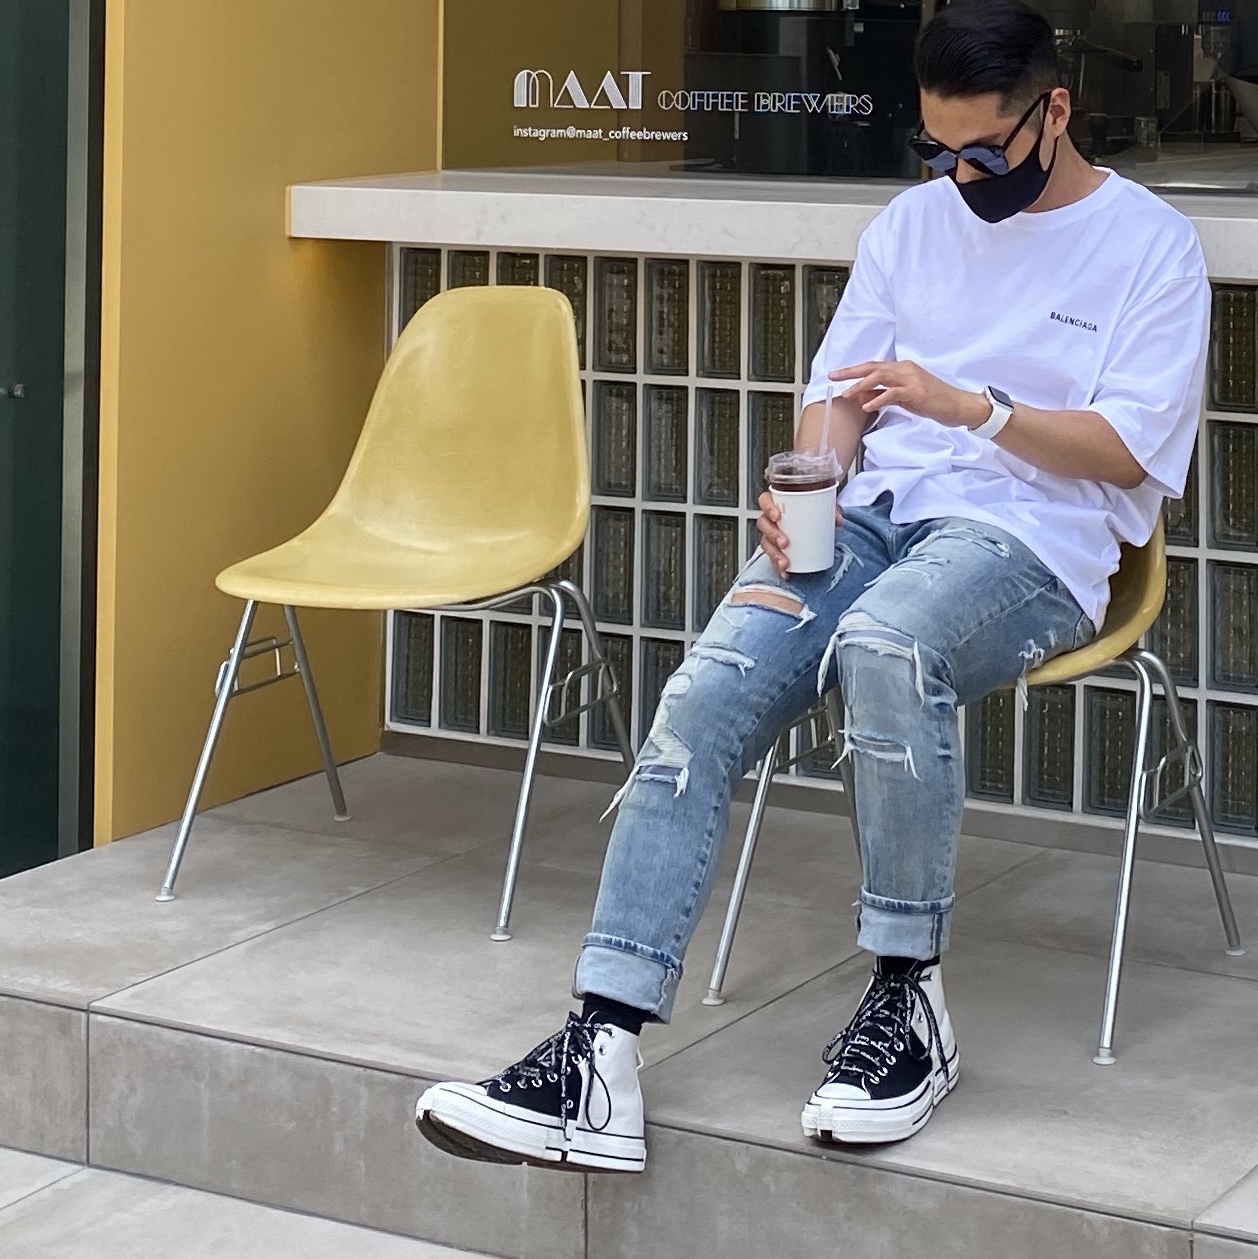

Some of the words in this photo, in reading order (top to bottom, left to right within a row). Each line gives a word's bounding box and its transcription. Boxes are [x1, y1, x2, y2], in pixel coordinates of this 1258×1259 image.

[514, 69, 652, 109] MAAT
[657, 90, 749, 112] COFFEE
[754, 92, 874, 116] BREWERS
[513, 124, 689, 141] instagram@maat_coffeebrewers
[1049, 311, 1098, 333] BALENCIAGA
